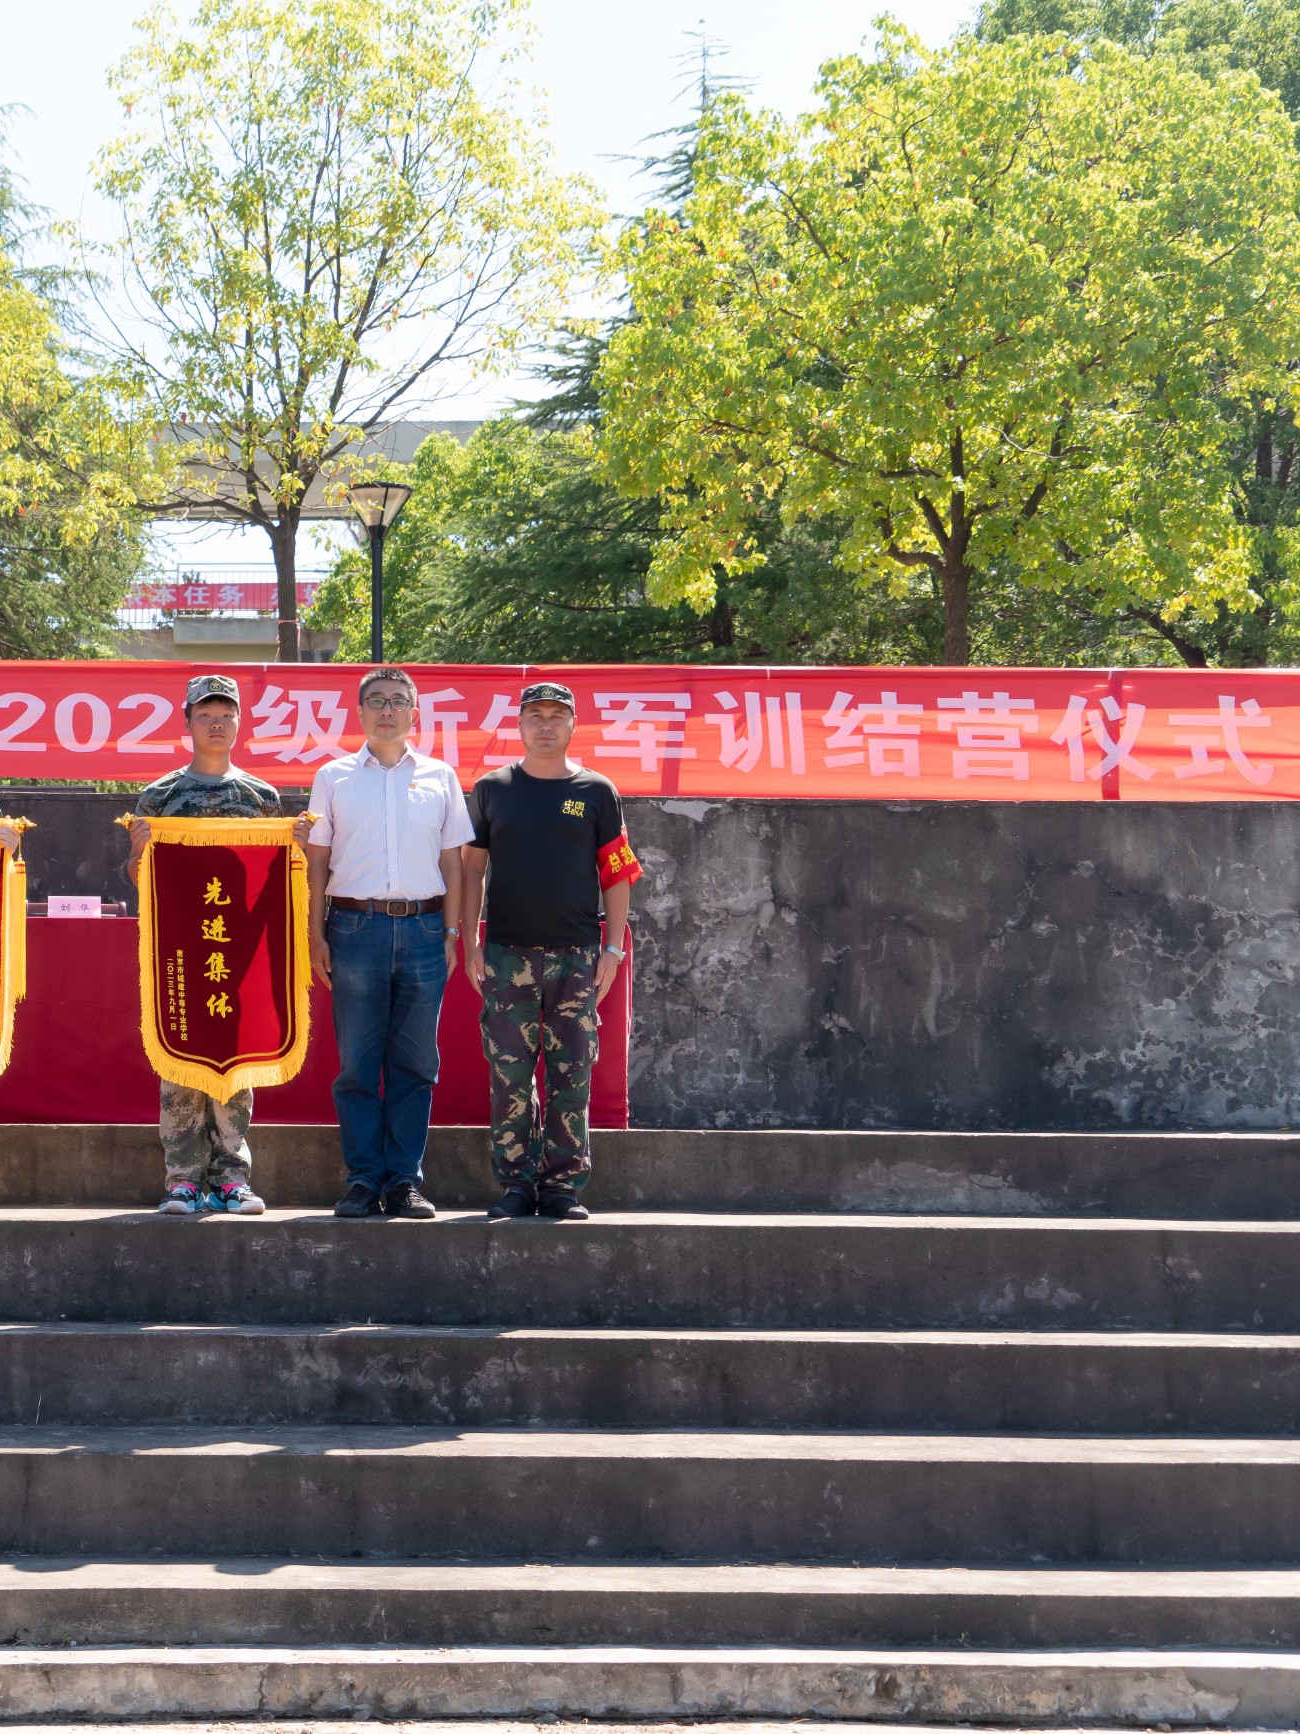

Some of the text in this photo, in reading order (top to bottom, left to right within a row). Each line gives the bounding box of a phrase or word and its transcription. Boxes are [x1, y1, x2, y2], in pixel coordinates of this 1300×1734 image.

[564, 799, 585, 811] 中国
[562, 808, 584, 818] CHINA
[201, 876, 233, 1019] 先进集体
